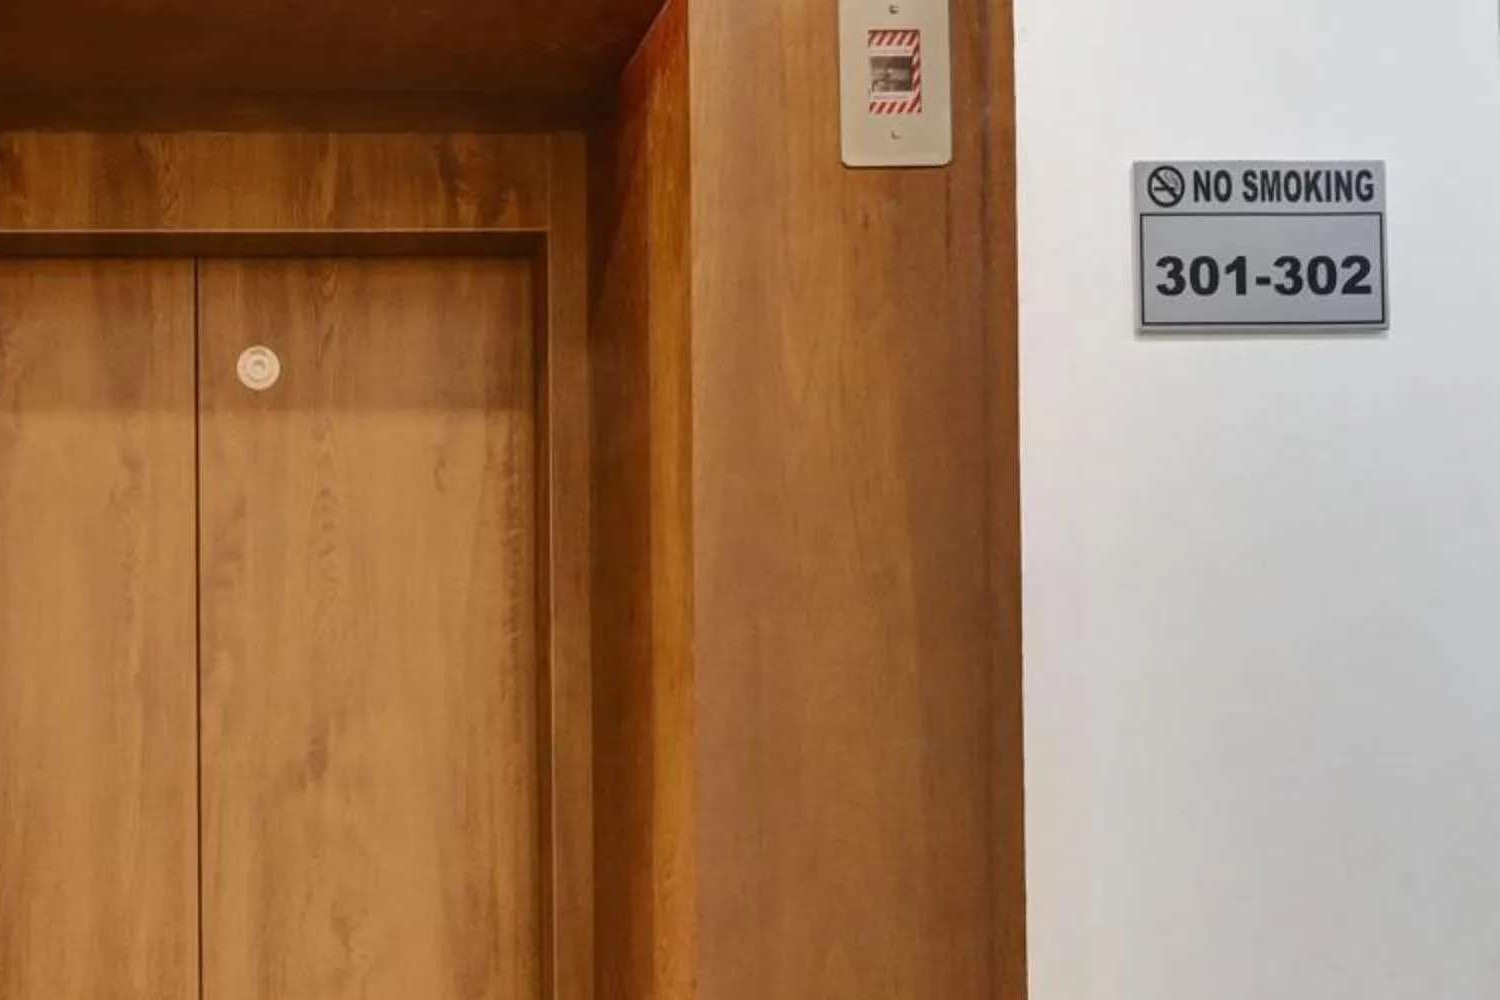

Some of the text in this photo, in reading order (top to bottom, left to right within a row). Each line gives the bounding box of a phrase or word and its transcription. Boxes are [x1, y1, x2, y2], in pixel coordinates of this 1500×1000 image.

[1193, 169, 1374, 202] NO SMOKING
[1155, 255, 1372, 296] 301-302
